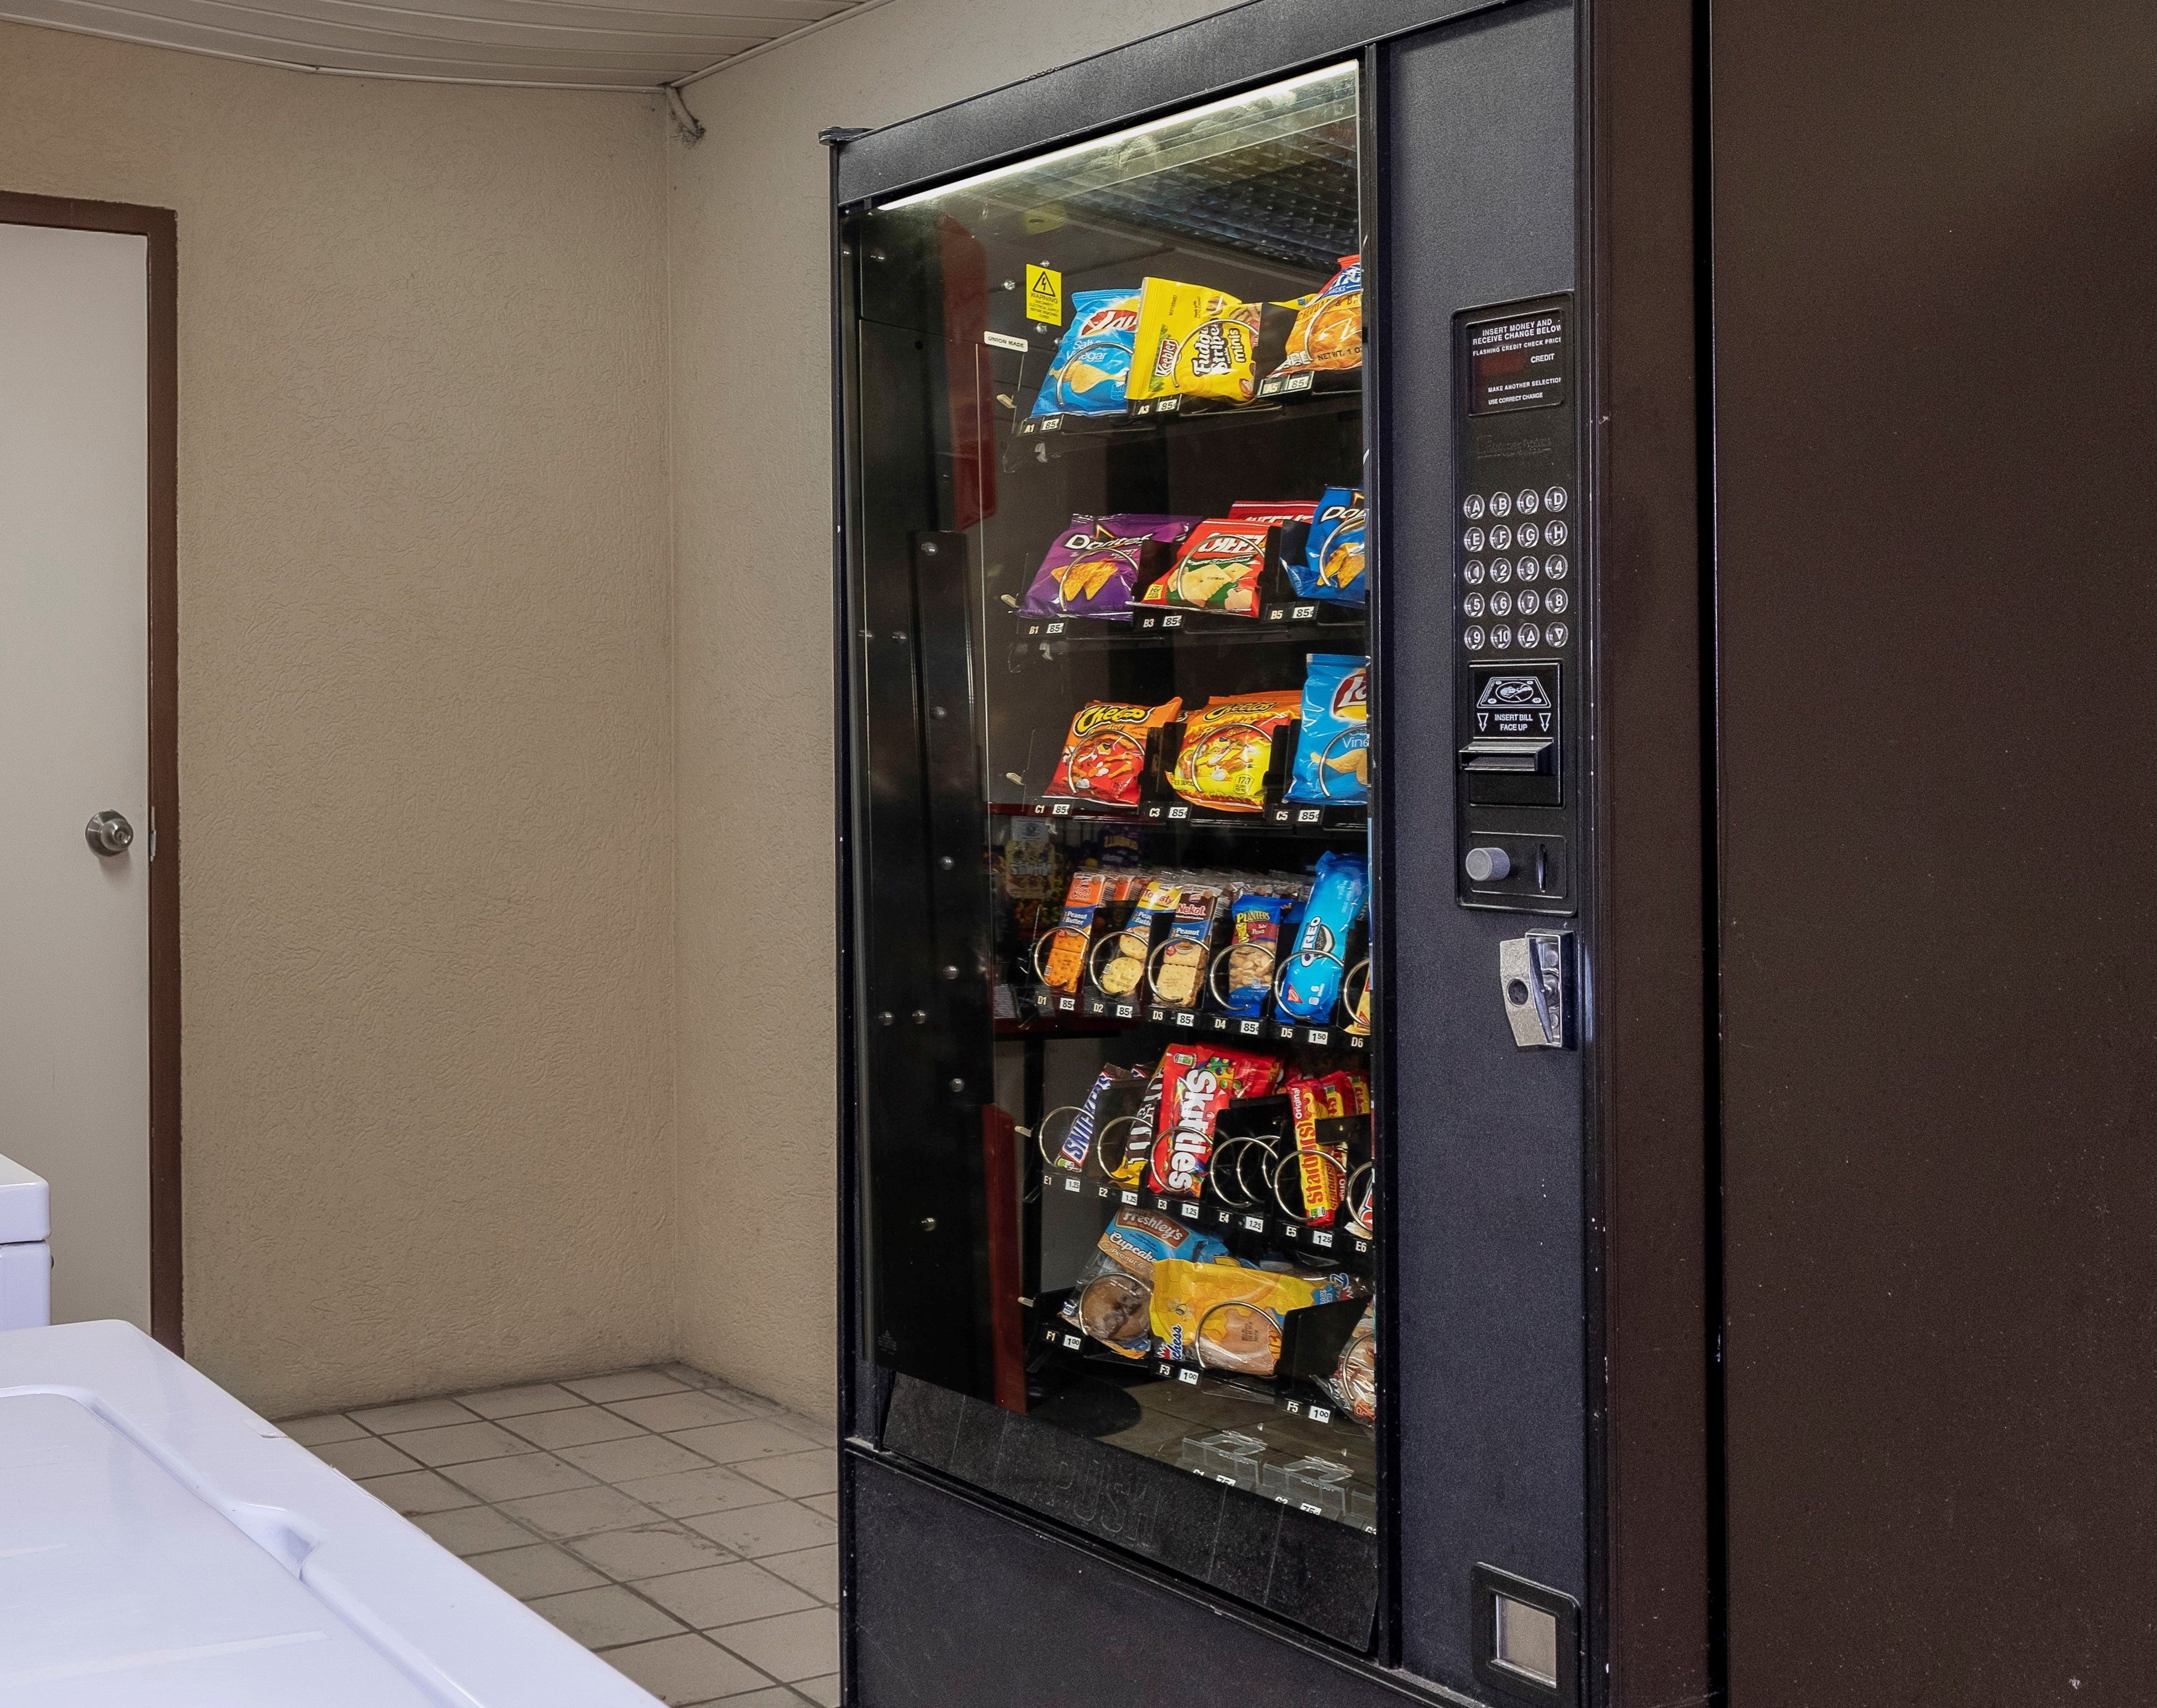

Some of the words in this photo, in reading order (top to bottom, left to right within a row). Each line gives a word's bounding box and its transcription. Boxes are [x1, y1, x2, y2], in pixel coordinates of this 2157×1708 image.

[1030, 292, 1058, 304] WARNING
[1482, 326, 1508, 336] INSERT
[1510, 321, 1535, 332] MONEY
[1536, 319, 1552, 327] AND
[1473, 335, 1502, 345] RECEIVE
[1504, 329, 1534, 340] CHANGE
[1536, 325, 1561, 335] BELOW
[1074, 339, 1093, 349] Salt
[1210, 324, 1229, 374] Stripe
[1229, 328, 1246, 363] minis
[1473, 347, 1500, 356] FLASHING
[1502, 343, 1522, 352] CREDIT
[1066, 350, 1108, 363] Vnegar
[1156, 340, 1177, 377] Keebler
[1317, 352, 1332, 361] NET
[1530, 353, 1555, 363] CREDIT
[1504, 382, 1530, 390] ANOTHER
[1499, 395, 1522, 404] CORRECT
[1137, 405, 1150, 415] A3
[1024, 424, 1035, 433] A1
[1270, 610, 1283, 620] B5
[1143, 618, 1155, 628] B3
[1029, 625, 1038, 635] B1
[1205, 703, 1272, 721] Cheetos
[1342, 737, 1369, 748] Vine
[1034, 805, 1045, 814] C1
[1149, 808, 1160, 817] C3
[1276, 811, 1288, 821] C5
[1143, 890, 1174, 904] Tosty
[1177, 903, 1206, 916] Nekot
[1067, 911, 1088, 920] Peanut
[1138, 911, 1152, 920] Pean
[1237, 911, 1270, 923] PLANTERS
[1066, 917, 1084, 926] Butter
[1176, 927, 1199, 936] Peanut
[1302, 916, 1321, 967] OREO
[1037, 996, 1046, 1005] D1
[1093, 1004, 1103, 1013] D2
[1153, 1010, 1163, 1021] D3
[1215, 1019, 1226, 1029] D4
[1281, 1027, 1293, 1039] D5
[1351, 1037, 1363, 1048] D6
[1293, 1087, 1302, 1119] Original
[1168, 1069, 1217, 1190] Skittles
[1297, 1119, 1324, 1205] Starburst
[1043, 1175, 1052, 1185] E1
[1099, 1187, 1108, 1197] E2
[1158, 1199, 1167, 1209] E3
[1219, 1212, 1229, 1223] E4
[1123, 1210, 1183, 1240] Freshley's
[1286, 1225, 1297, 1238] E5
[1109, 1231, 1158, 1263] Cupcake
[1356, 1240, 1367, 1253] E6
[1046, 1331, 1055, 1341] F1
[1159, 1366, 1170, 1376] F3
[1287, 1401, 1299, 1413] F5
